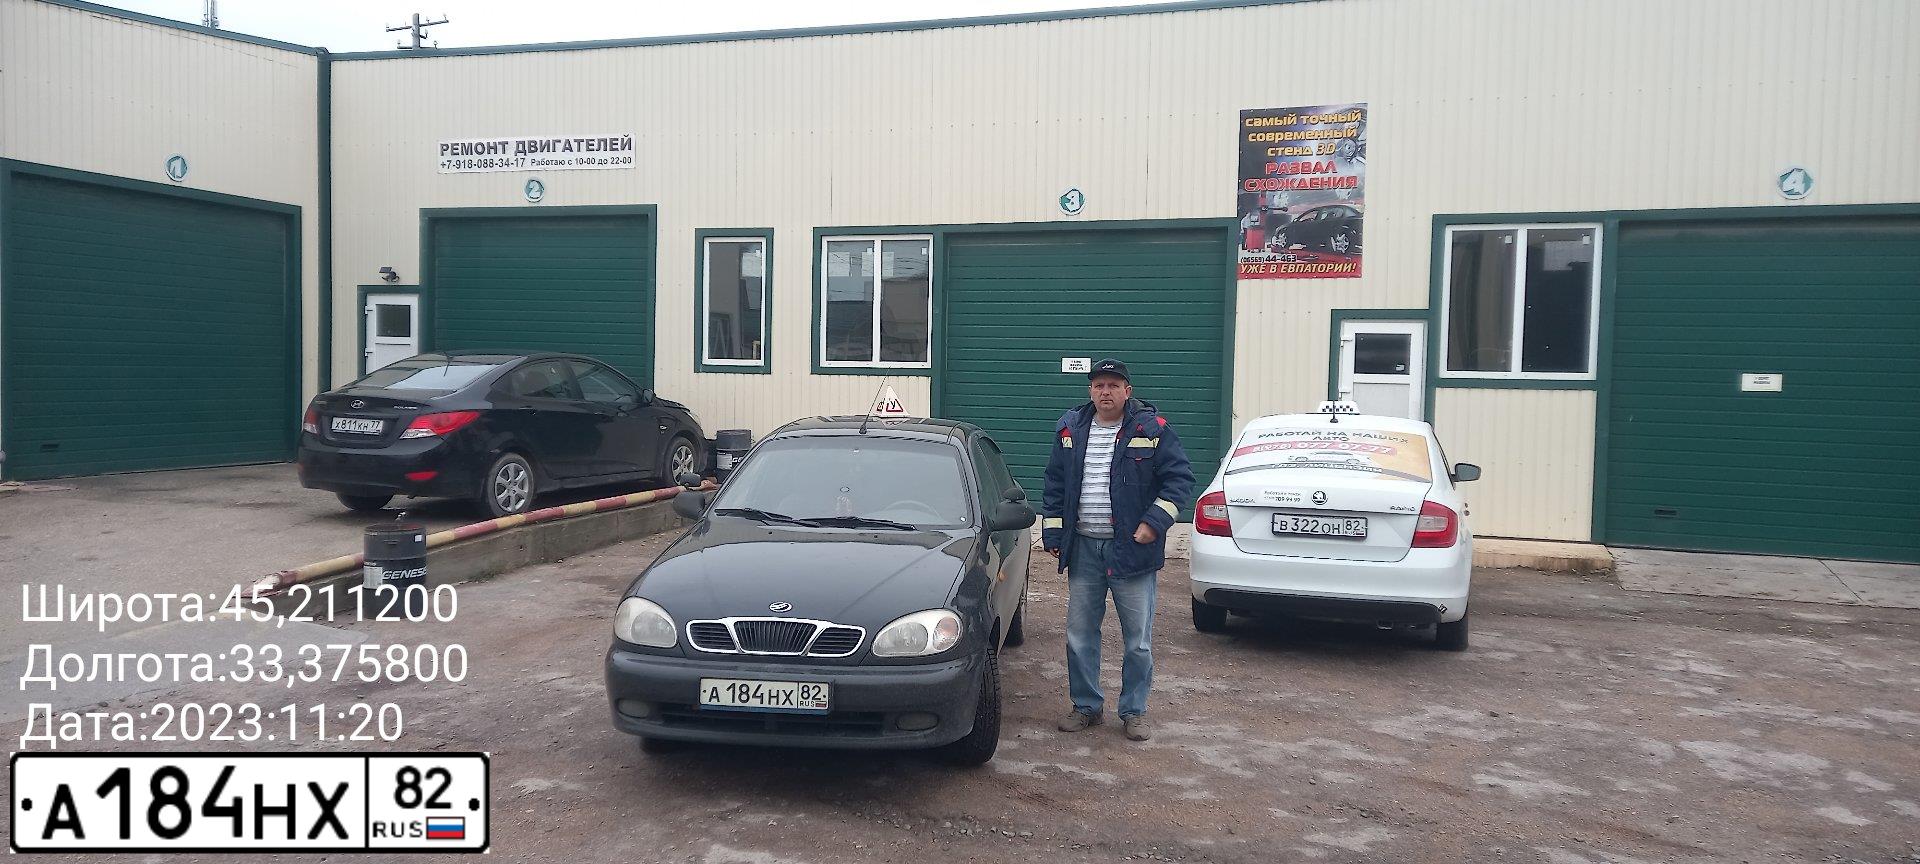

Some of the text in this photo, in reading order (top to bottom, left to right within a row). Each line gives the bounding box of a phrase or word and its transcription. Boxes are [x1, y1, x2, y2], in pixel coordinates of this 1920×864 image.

[1245, 110, 1362, 127] самый точный
[1248, 127, 1357, 143] современный
[440, 134, 632, 156] РЕМОНТ ДВИГАТЕЛЕЙ
[1267, 142, 1337, 157] стенд 3D
[440, 157, 526, 170] +7-918-088-34-17
[530, 158, 566, 167] Работаю
[574, 157, 596, 166] 10-00
[597, 157, 609, 166] до
[610, 156, 632, 165] 22-00
[1265, 160, 1338, 175] РАЗВАЛ
[1244, 175, 1358, 191] СХОЖДЕНИЯ
[1265, 254, 1298, 263] 44-463
[1240, 263, 1357, 274] УЖЕ В ЕВПАТОРИИ!
[371, 420, 381, 429] 77
[1345, 520, 1361, 531] 82
[708, 682, 822, 706] А184НХ 82
[799, 700, 815, 708] RUS
